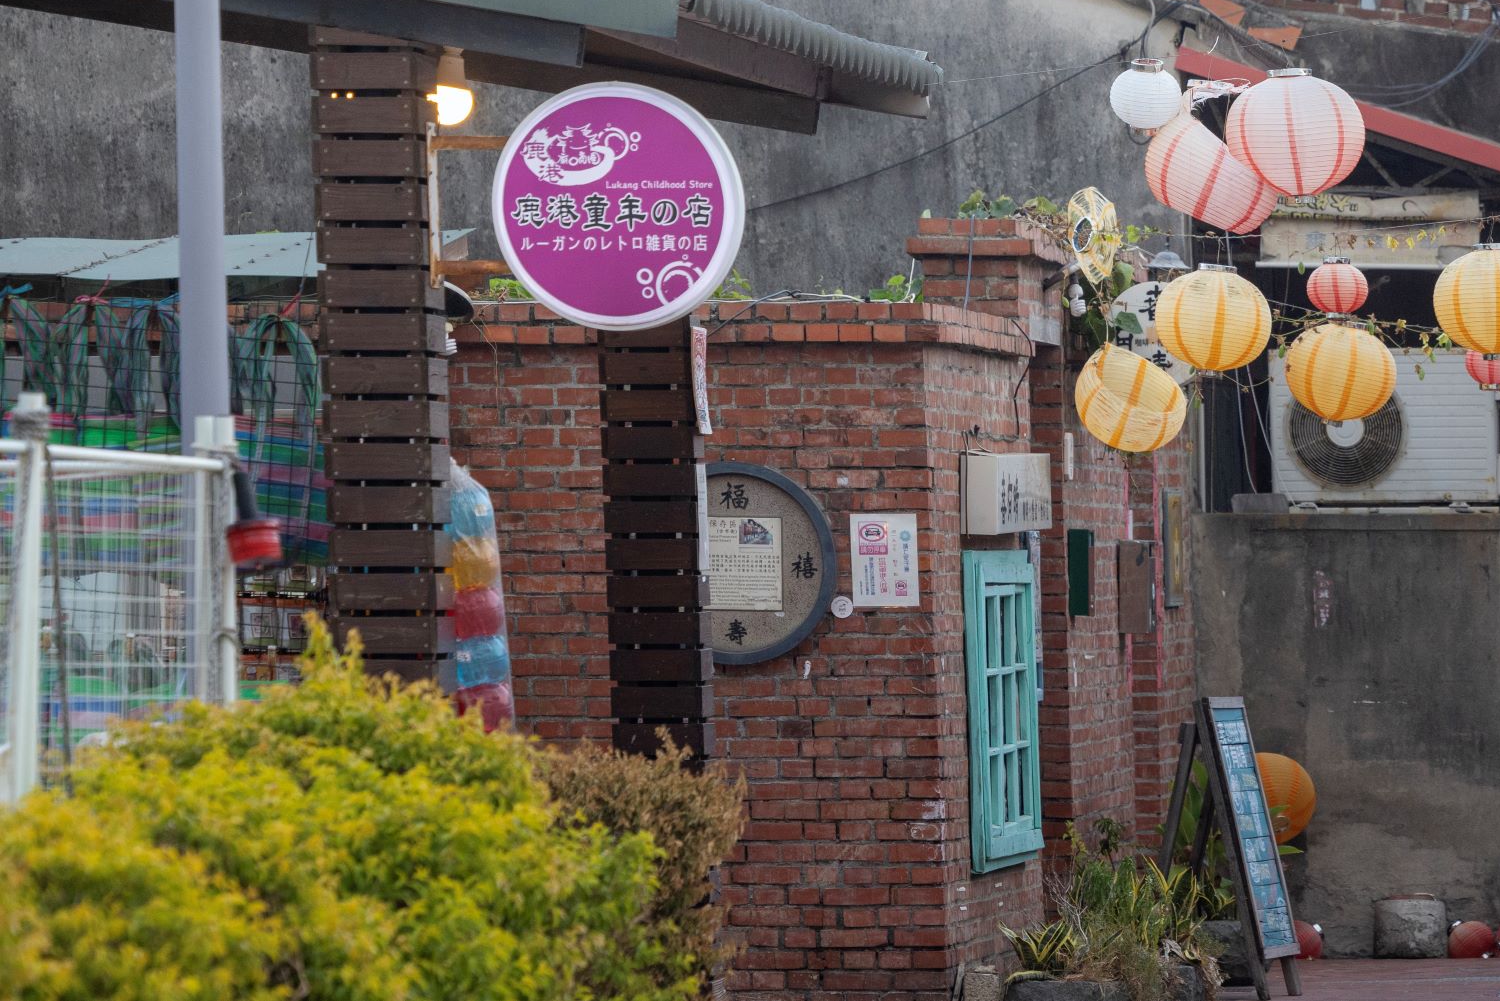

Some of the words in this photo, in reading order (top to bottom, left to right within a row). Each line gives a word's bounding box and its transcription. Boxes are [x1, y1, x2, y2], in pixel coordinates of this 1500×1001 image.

[605, 180, 639, 190] Lukang
[640, 180, 686, 189] Childhood
[689, 180, 713, 189] Store
[511, 192, 713, 232] 鹿港童年の店
[520, 234, 708, 253] ルーガンのレトロ雑貨の店
[720, 482, 749, 510] 福
[791, 552, 818, 580] 禧
[725, 619, 748, 645] 壽
